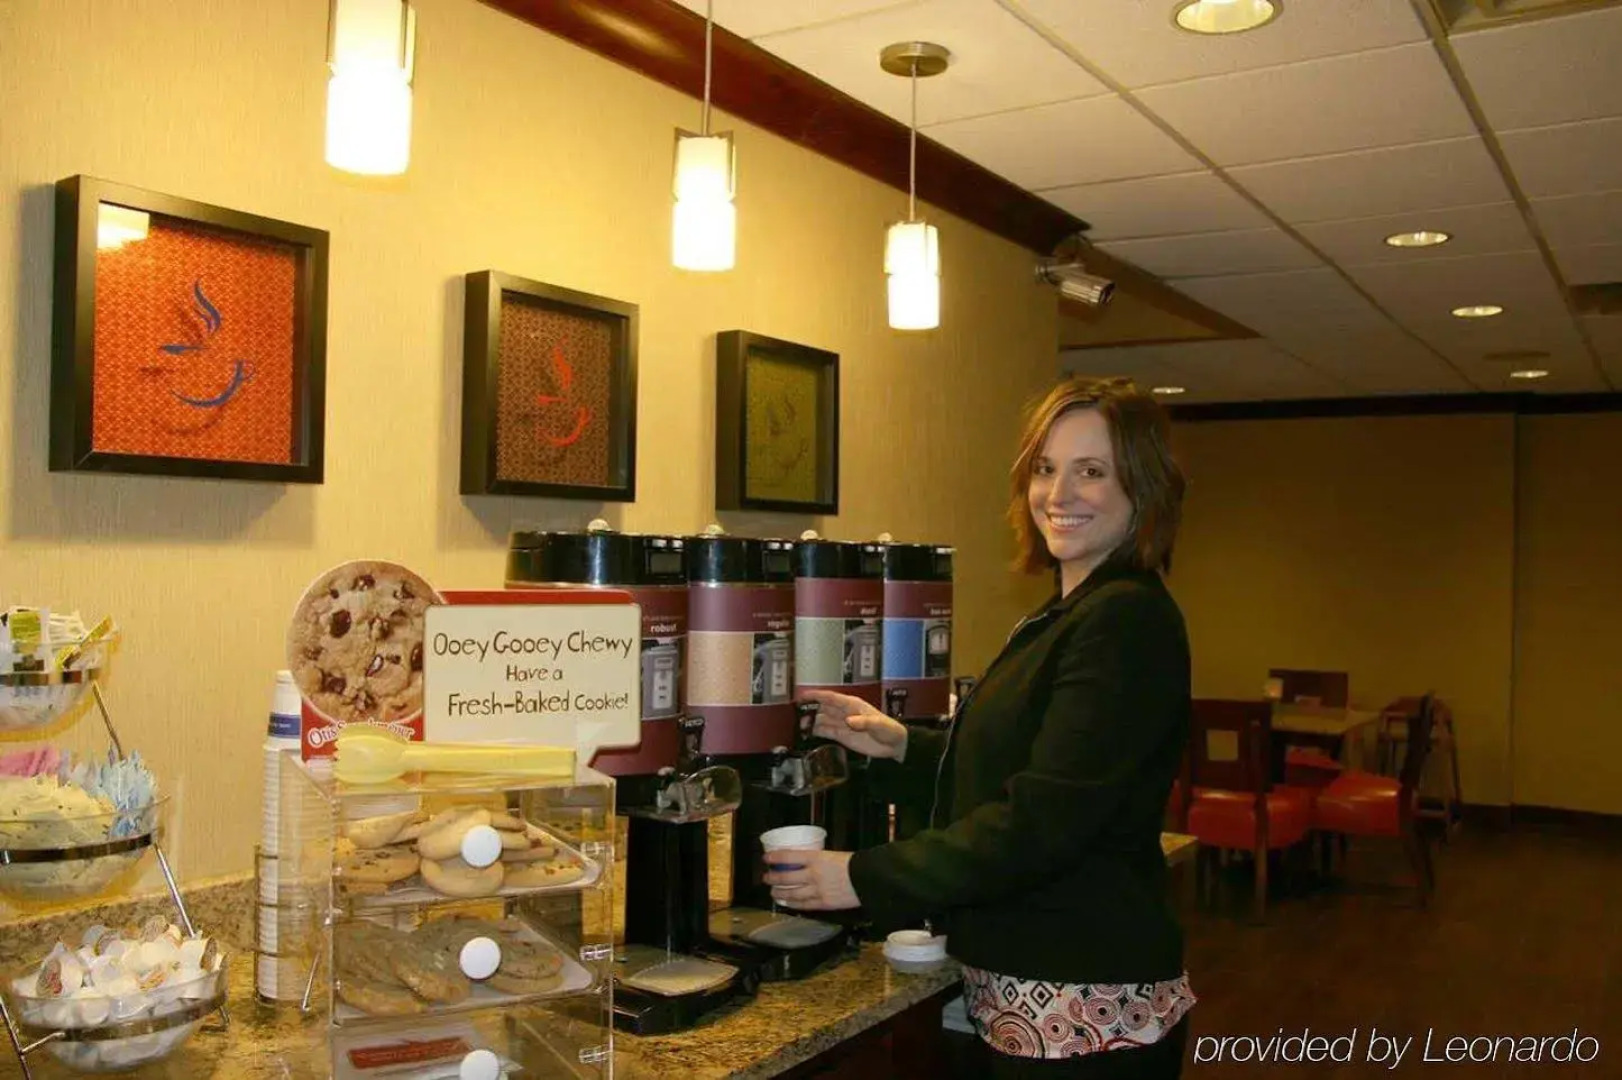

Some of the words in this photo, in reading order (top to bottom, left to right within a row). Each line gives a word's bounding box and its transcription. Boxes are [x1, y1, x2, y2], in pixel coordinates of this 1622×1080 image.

[433, 631, 489, 662] Ooey
[493, 630, 563, 660] Gooey
[567, 629, 633, 659] Chewy
[506, 664, 549, 682] Have
[552, 667, 563, 681] a
[448, 690, 570, 717] Fresh-Baked
[574, 692, 628, 711] Cookie!
